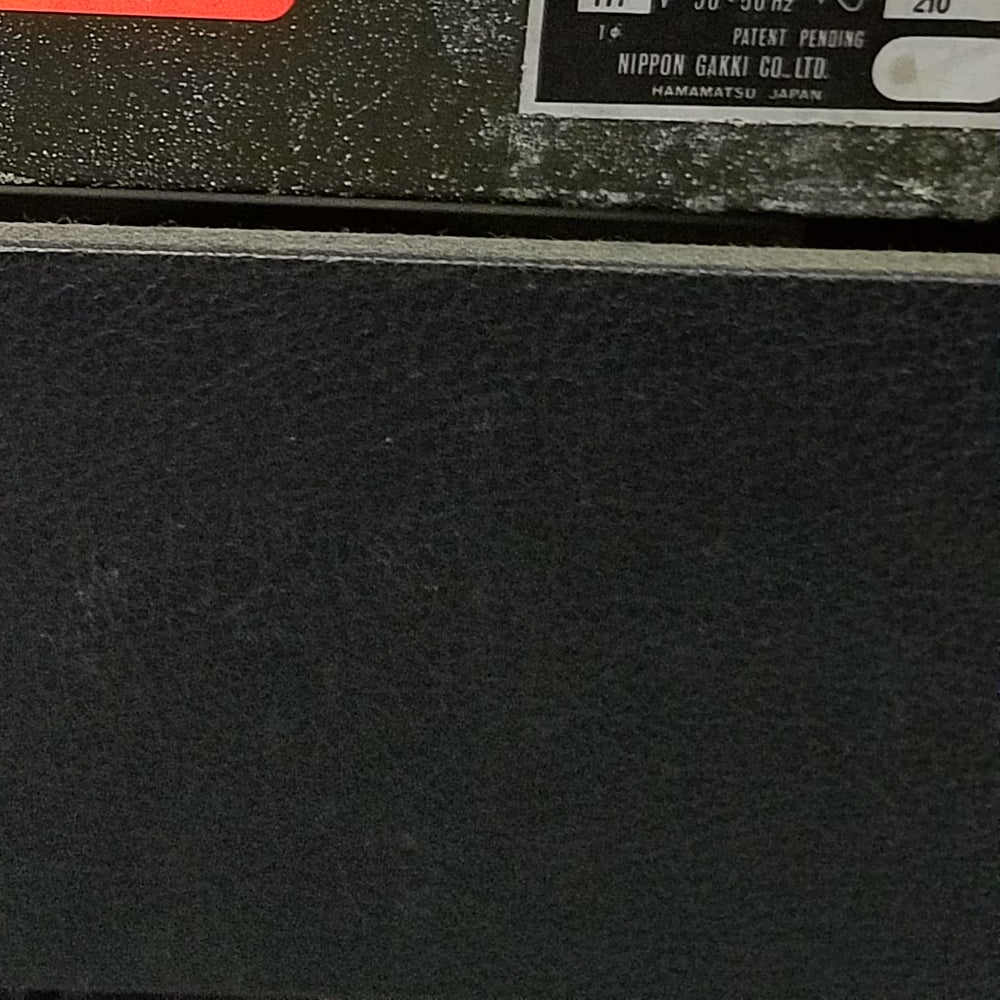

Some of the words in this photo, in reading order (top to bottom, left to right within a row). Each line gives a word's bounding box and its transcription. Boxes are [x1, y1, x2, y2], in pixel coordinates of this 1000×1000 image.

[733, 27, 787, 45] PATENT
[799, 29, 867, 48] PENDING
[618, 53, 685, 76] NIPPON
[695, 55, 748, 78] GAKKI
[652, 85, 757, 99] HAMAMATSU
[768, 88, 822, 100] JAPAN
